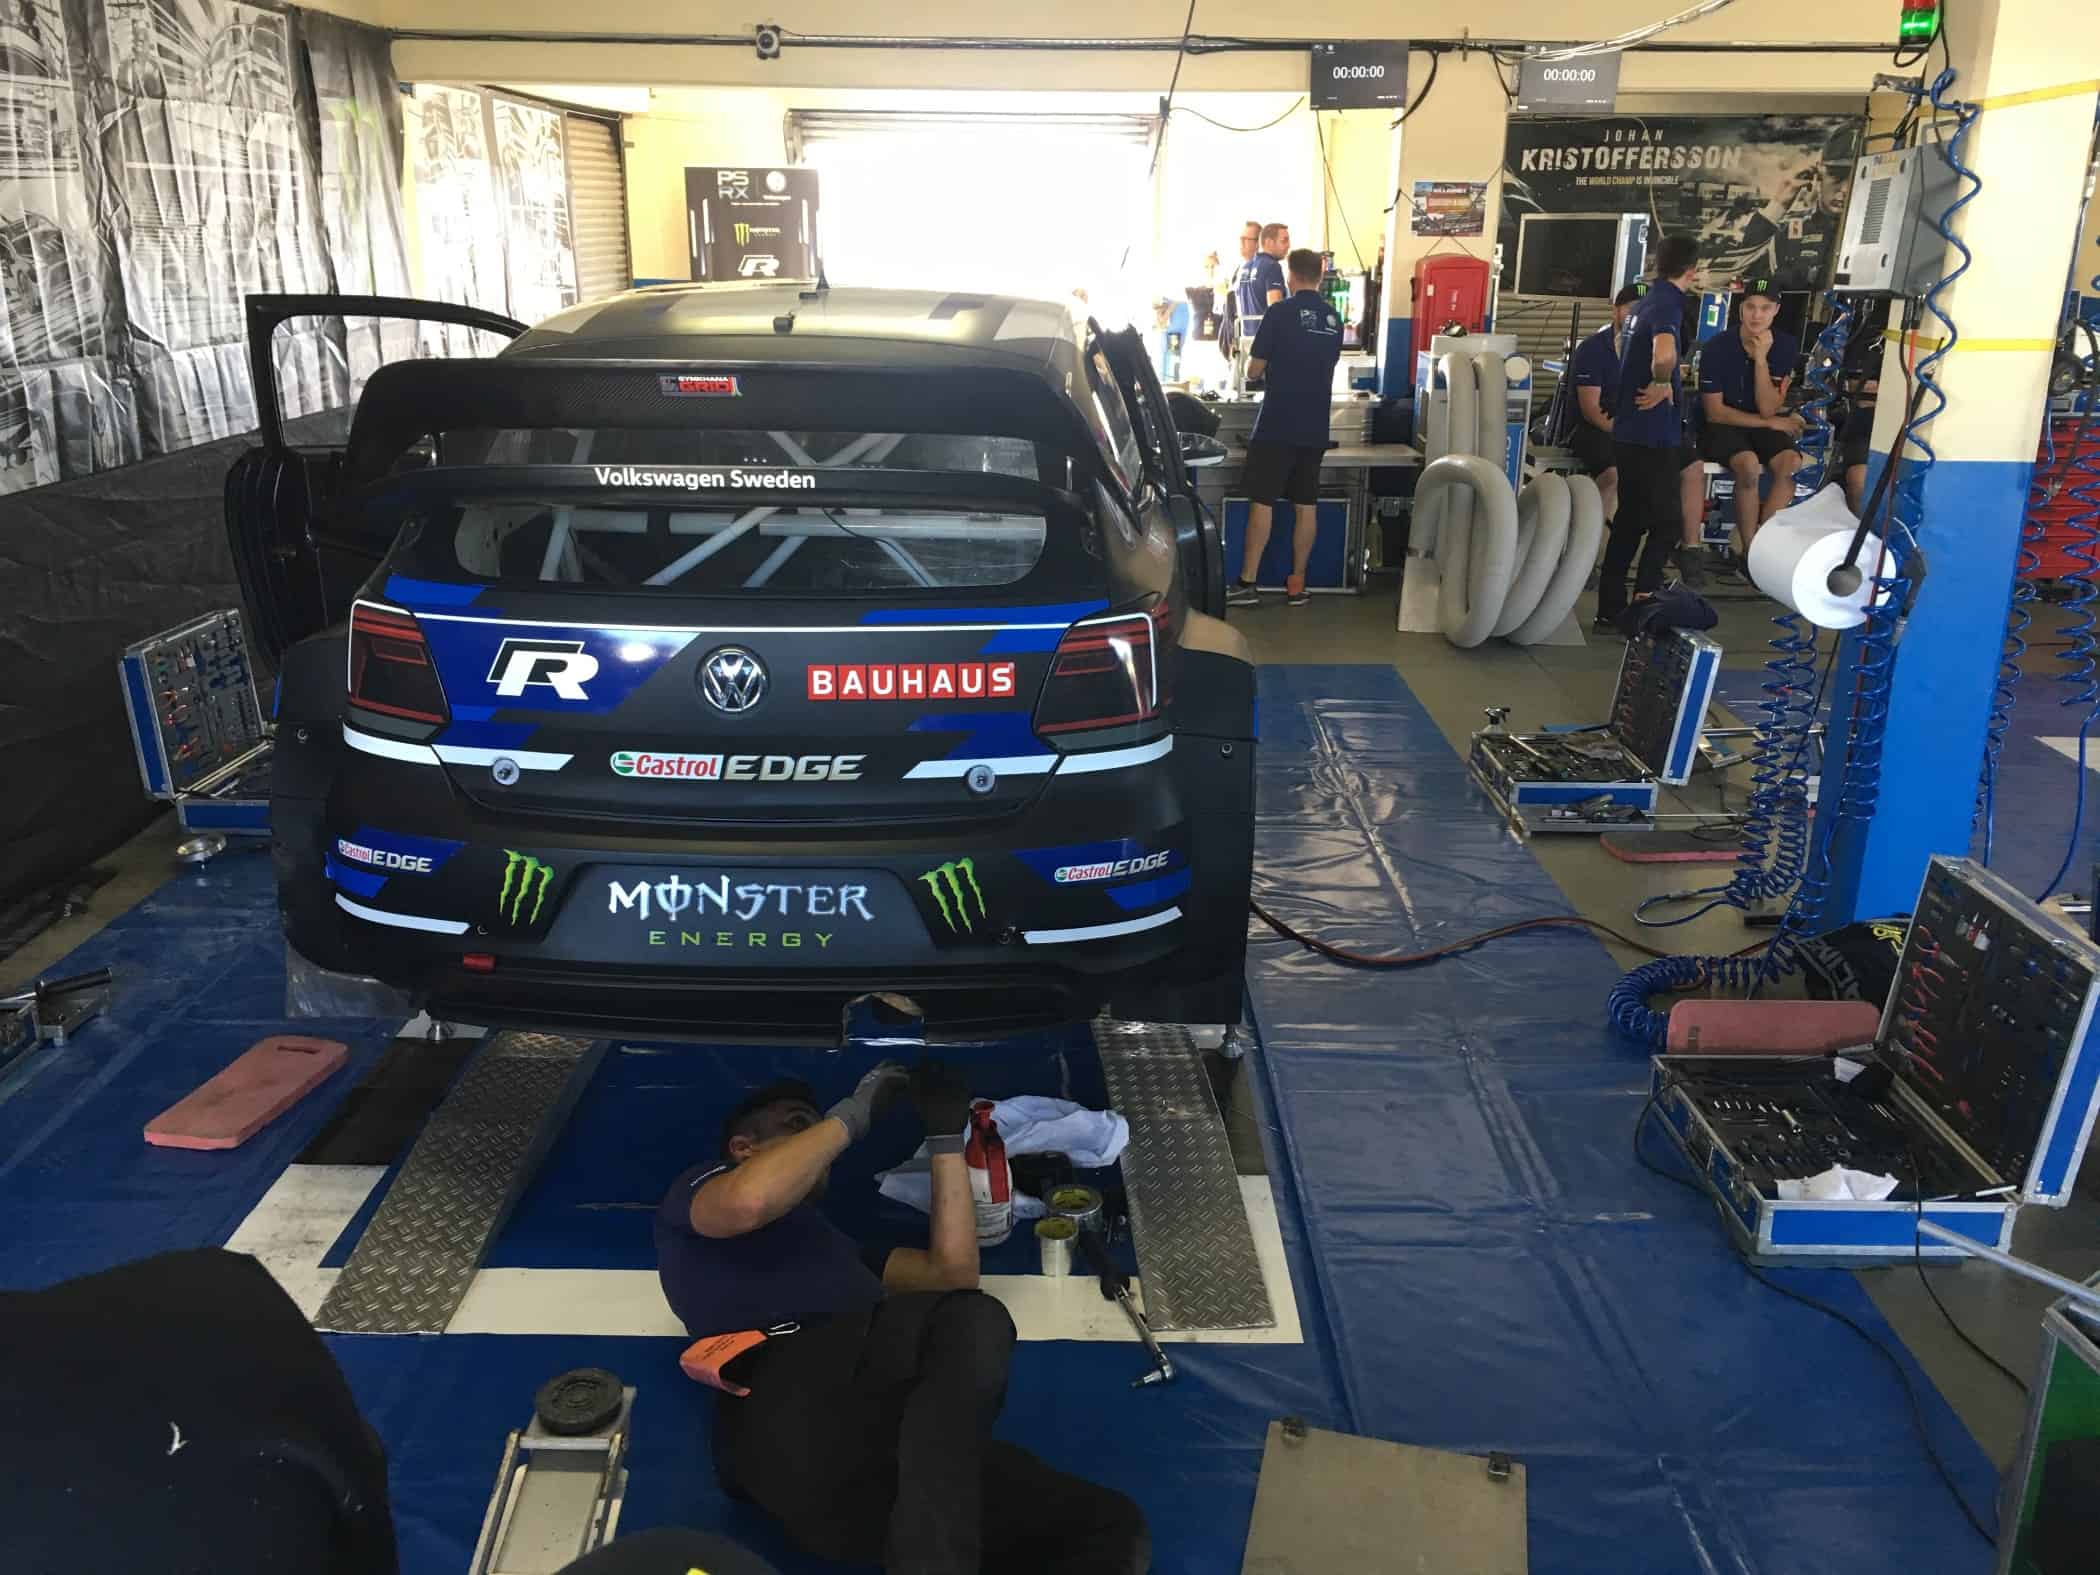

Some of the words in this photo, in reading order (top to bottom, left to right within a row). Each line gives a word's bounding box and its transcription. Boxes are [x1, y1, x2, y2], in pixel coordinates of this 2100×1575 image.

[1332, 65, 1385, 79] 00:00:00
[1543, 68, 1596, 82] 00:00:00
[1603, 129, 1665, 143] JOHAN
[1521, 144, 1744, 172] KRISTOFFERSSON
[594, 467, 725, 490] Volkswagen
[730, 470, 816, 489] Sweden
[811, 667, 1014, 695] BAUHAUS
[636, 753, 718, 778] Castrol
[723, 754, 868, 781] EDGE
[373, 850, 433, 873] EDGE
[1068, 862, 1112, 880] Castrol
[1112, 849, 1170, 877] EDGE
[649, 931, 833, 948] ENERGY
